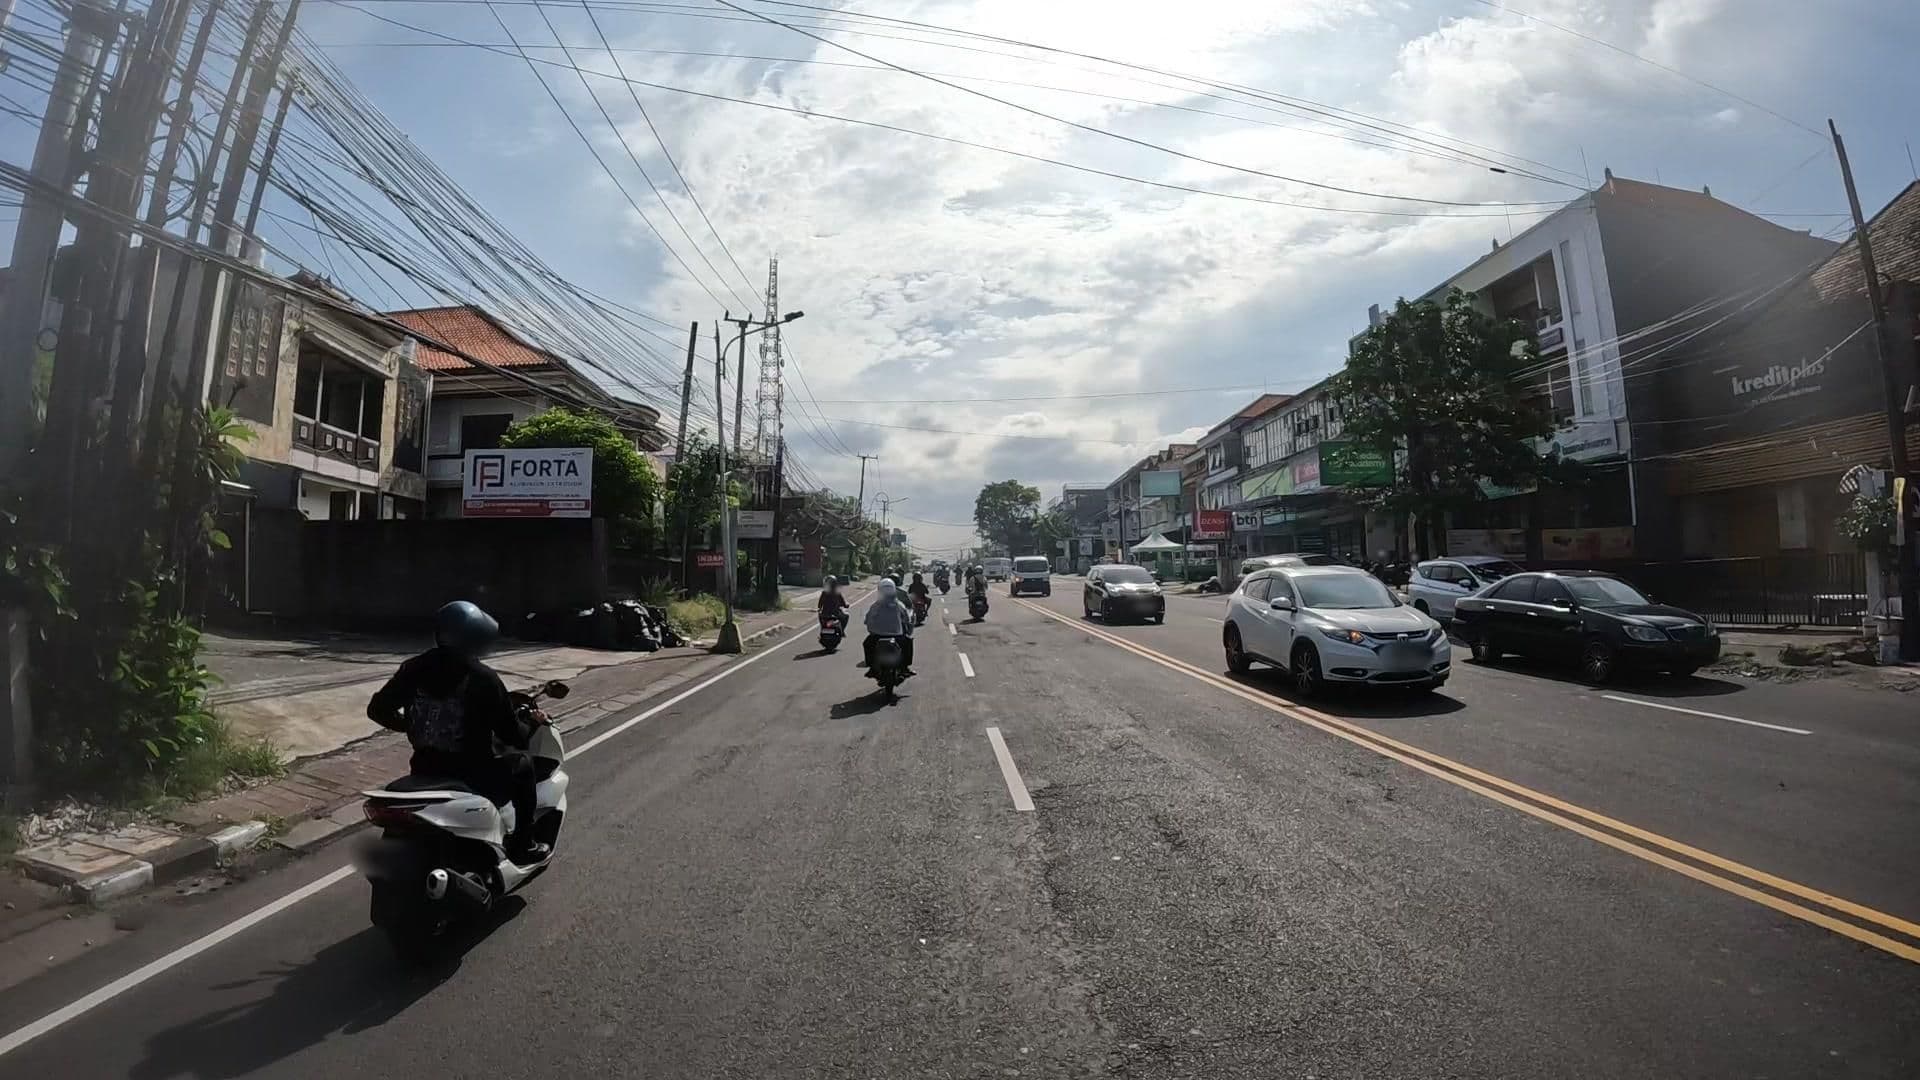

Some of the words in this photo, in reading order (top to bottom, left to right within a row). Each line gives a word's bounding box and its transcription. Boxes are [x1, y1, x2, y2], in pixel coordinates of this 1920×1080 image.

[1731, 357, 1825, 396] kreditplus
[511, 459, 579, 477] FORTA
[1236, 515, 1257, 525] btn
